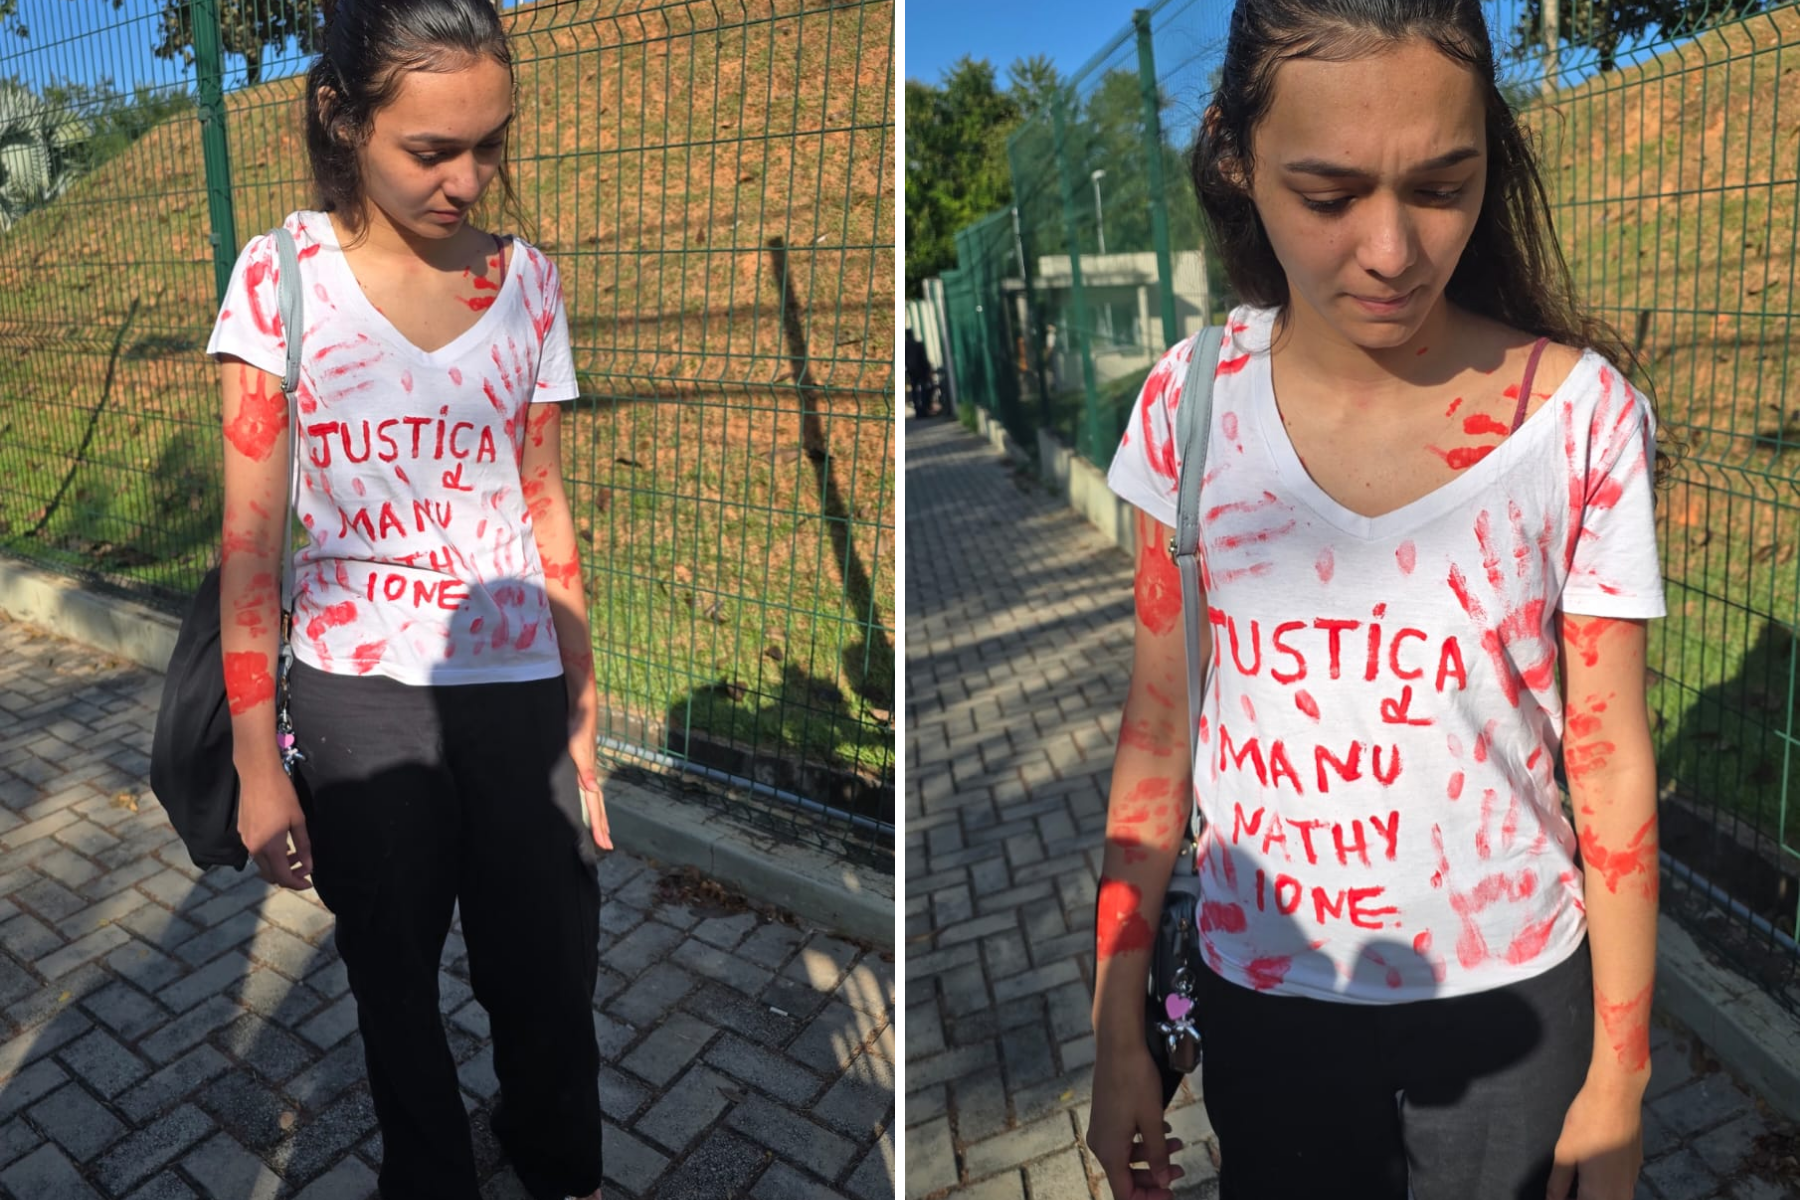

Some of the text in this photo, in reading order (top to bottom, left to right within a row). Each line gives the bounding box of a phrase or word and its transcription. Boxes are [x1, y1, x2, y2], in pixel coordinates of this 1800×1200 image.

[338, 499, 452, 541] MANU
[1219, 724, 1403, 794] MANU
[1232, 802, 1400, 867] NATHY
